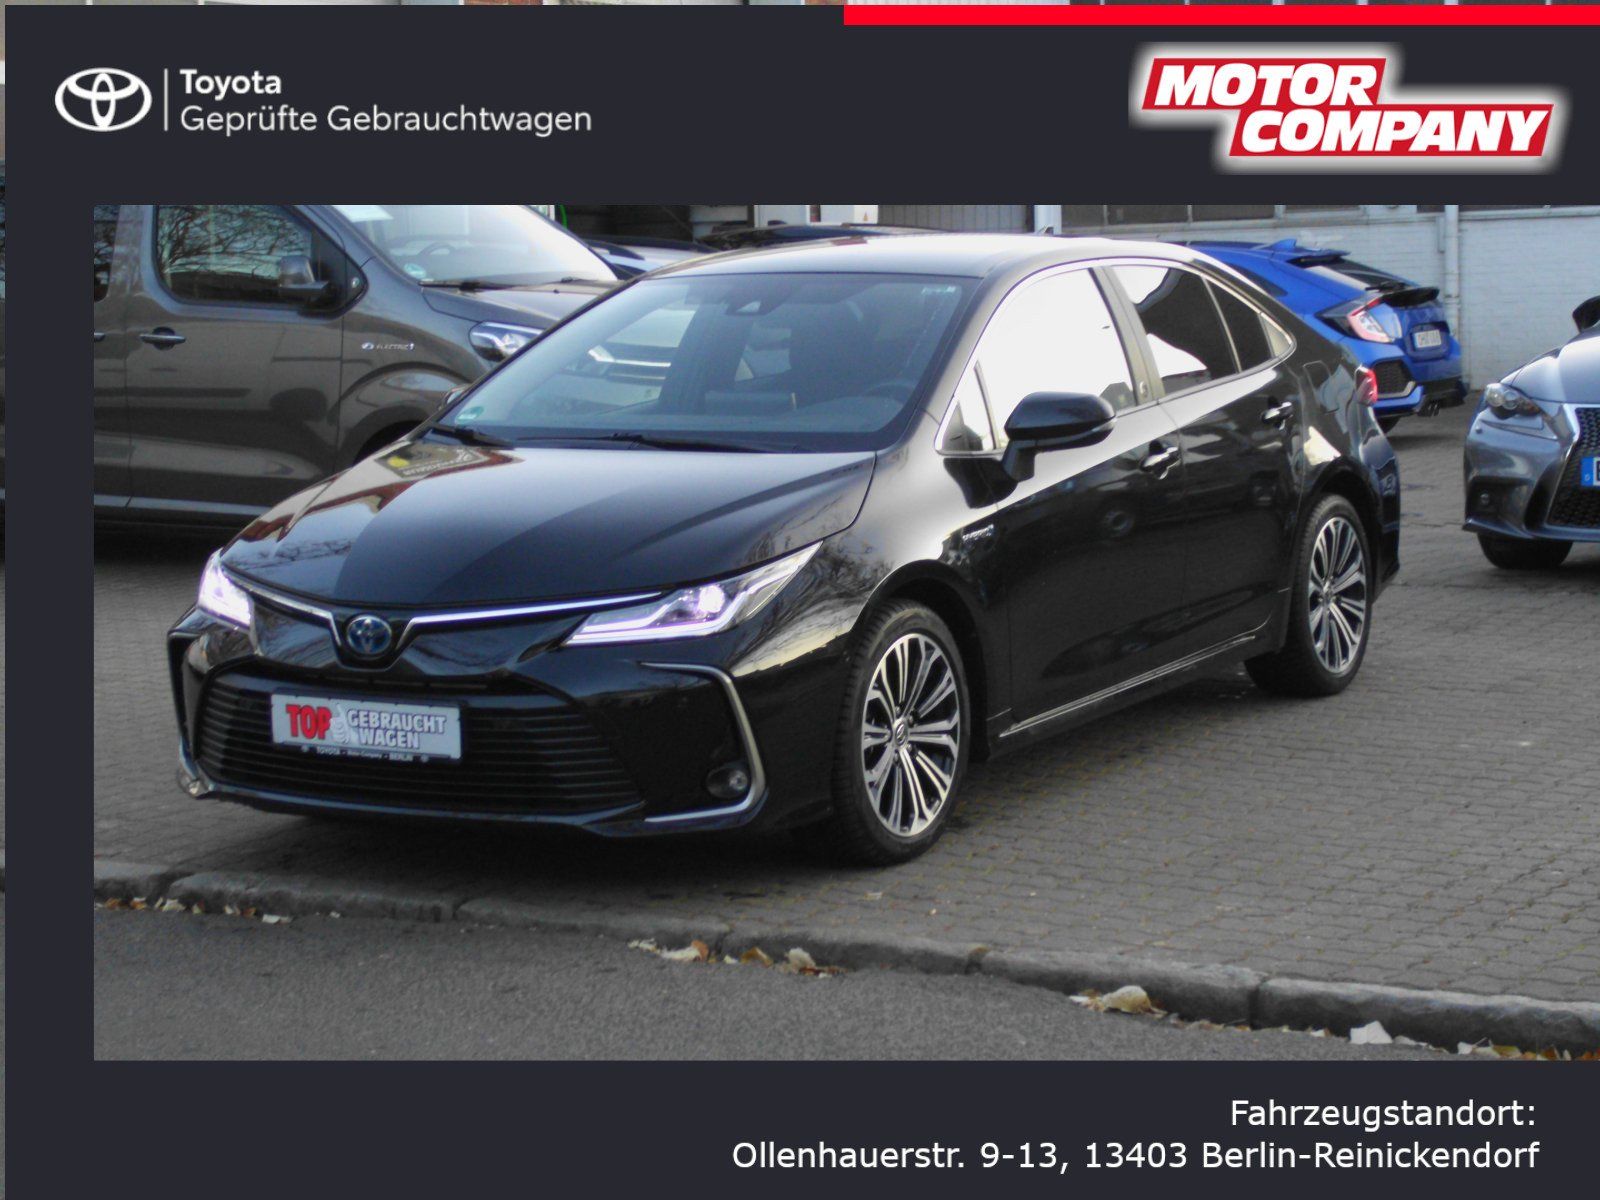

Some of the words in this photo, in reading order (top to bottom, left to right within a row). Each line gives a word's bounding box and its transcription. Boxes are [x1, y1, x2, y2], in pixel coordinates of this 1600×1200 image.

[285, 703, 333, 740] TOP
[347, 708, 447, 735] GEBRAUCHT
[357, 727, 421, 749] WAGEN
